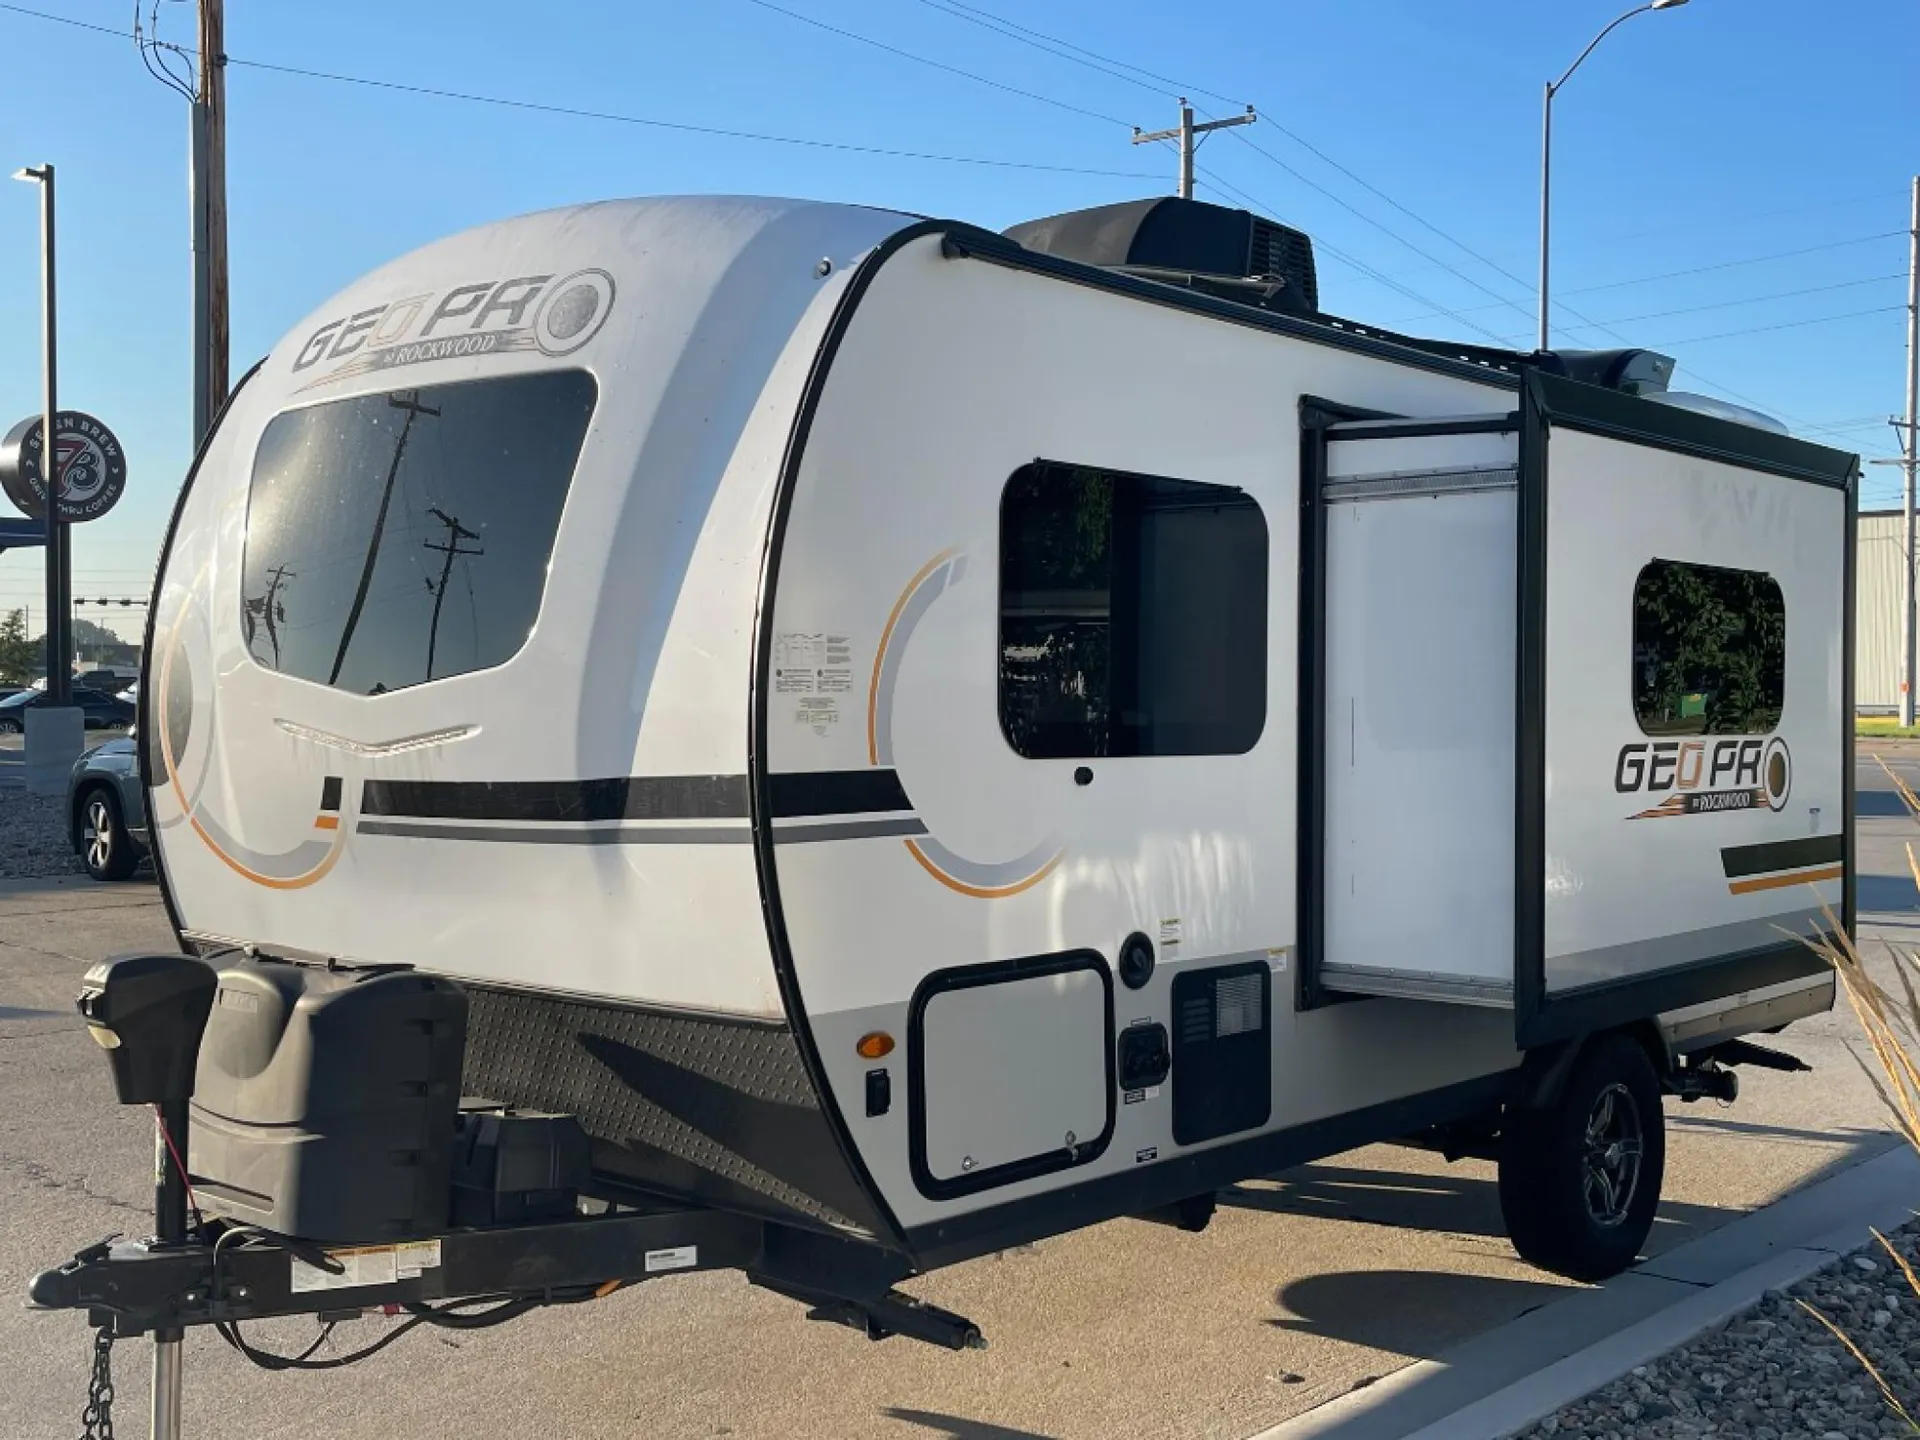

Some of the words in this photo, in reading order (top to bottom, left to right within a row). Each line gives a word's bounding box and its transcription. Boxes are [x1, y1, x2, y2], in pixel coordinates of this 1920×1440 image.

[292, 291, 435, 373] GEO
[395, 334, 498, 365] ROCKWOOD
[1614, 740, 1707, 794] GEO
[1709, 736, 1792, 813] PRO
[1699, 792, 1751, 811] ROCKWOOD
